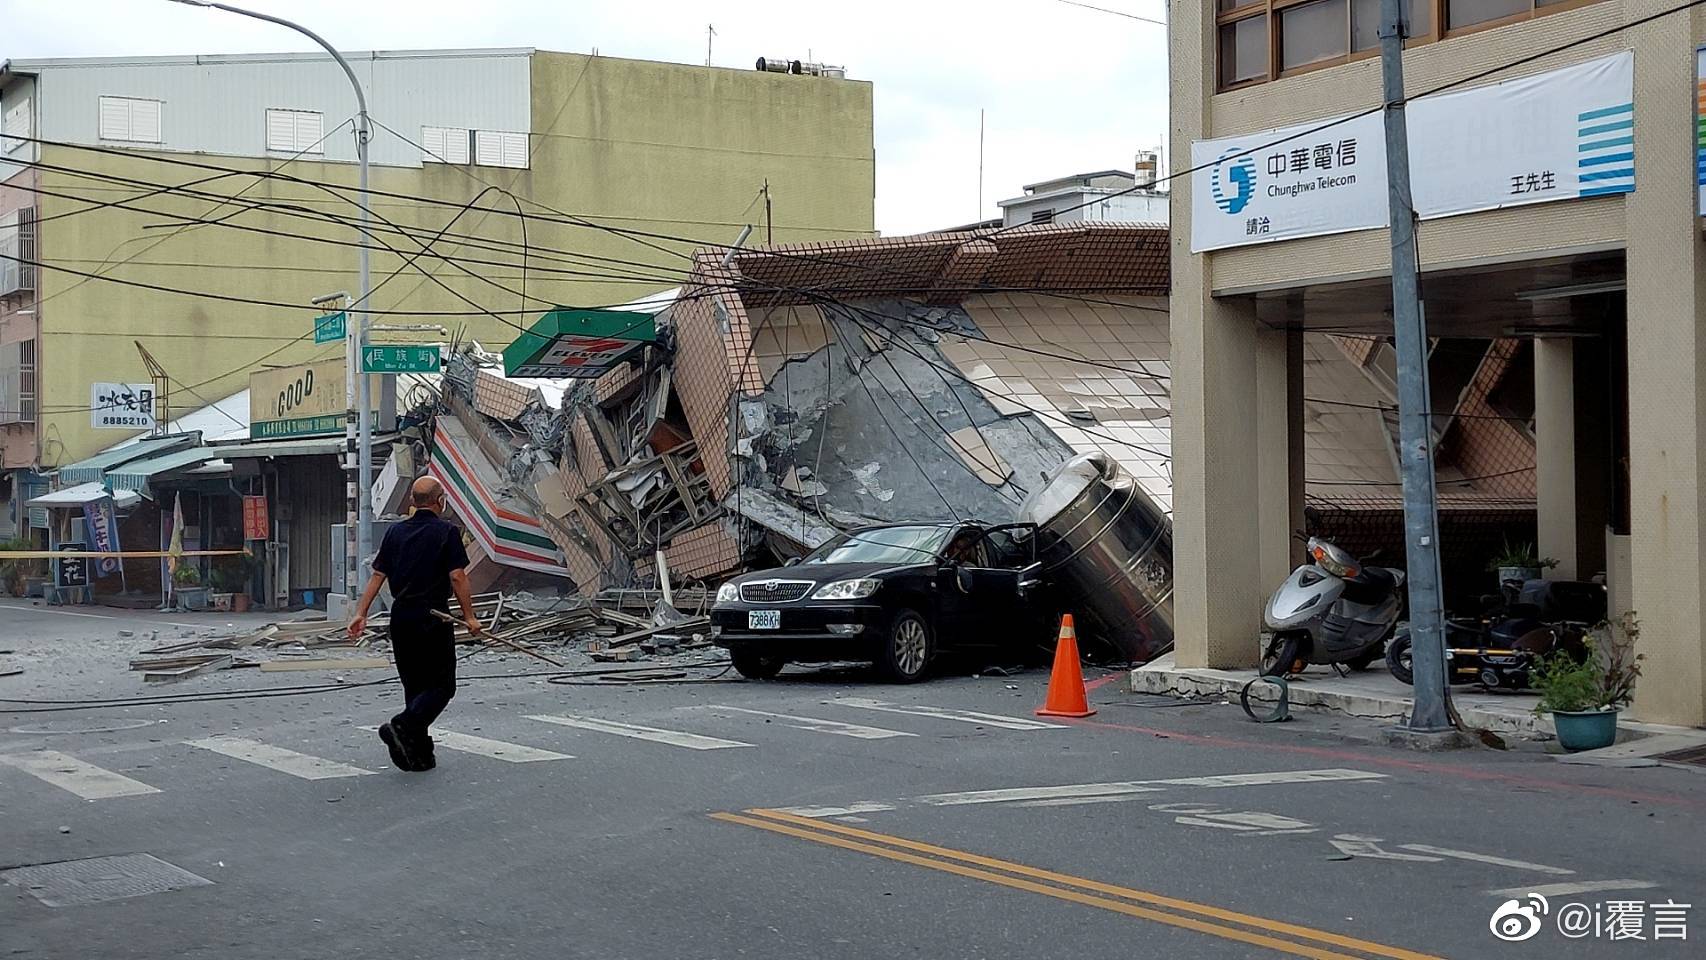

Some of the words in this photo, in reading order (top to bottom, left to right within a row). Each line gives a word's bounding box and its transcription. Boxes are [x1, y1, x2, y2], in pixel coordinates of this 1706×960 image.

[1267, 138, 1357, 178] 中華電信
[1267, 179, 1316, 198] Chunghwa
[1317, 174, 1357, 190] Telecom
[1510, 170, 1556, 195] 王先生
[1246, 216, 1270, 235] 請洽
[373, 348, 430, 362] 民族街
[278, 369, 313, 417] GOOD
[103, 416, 148, 425] 8885210
